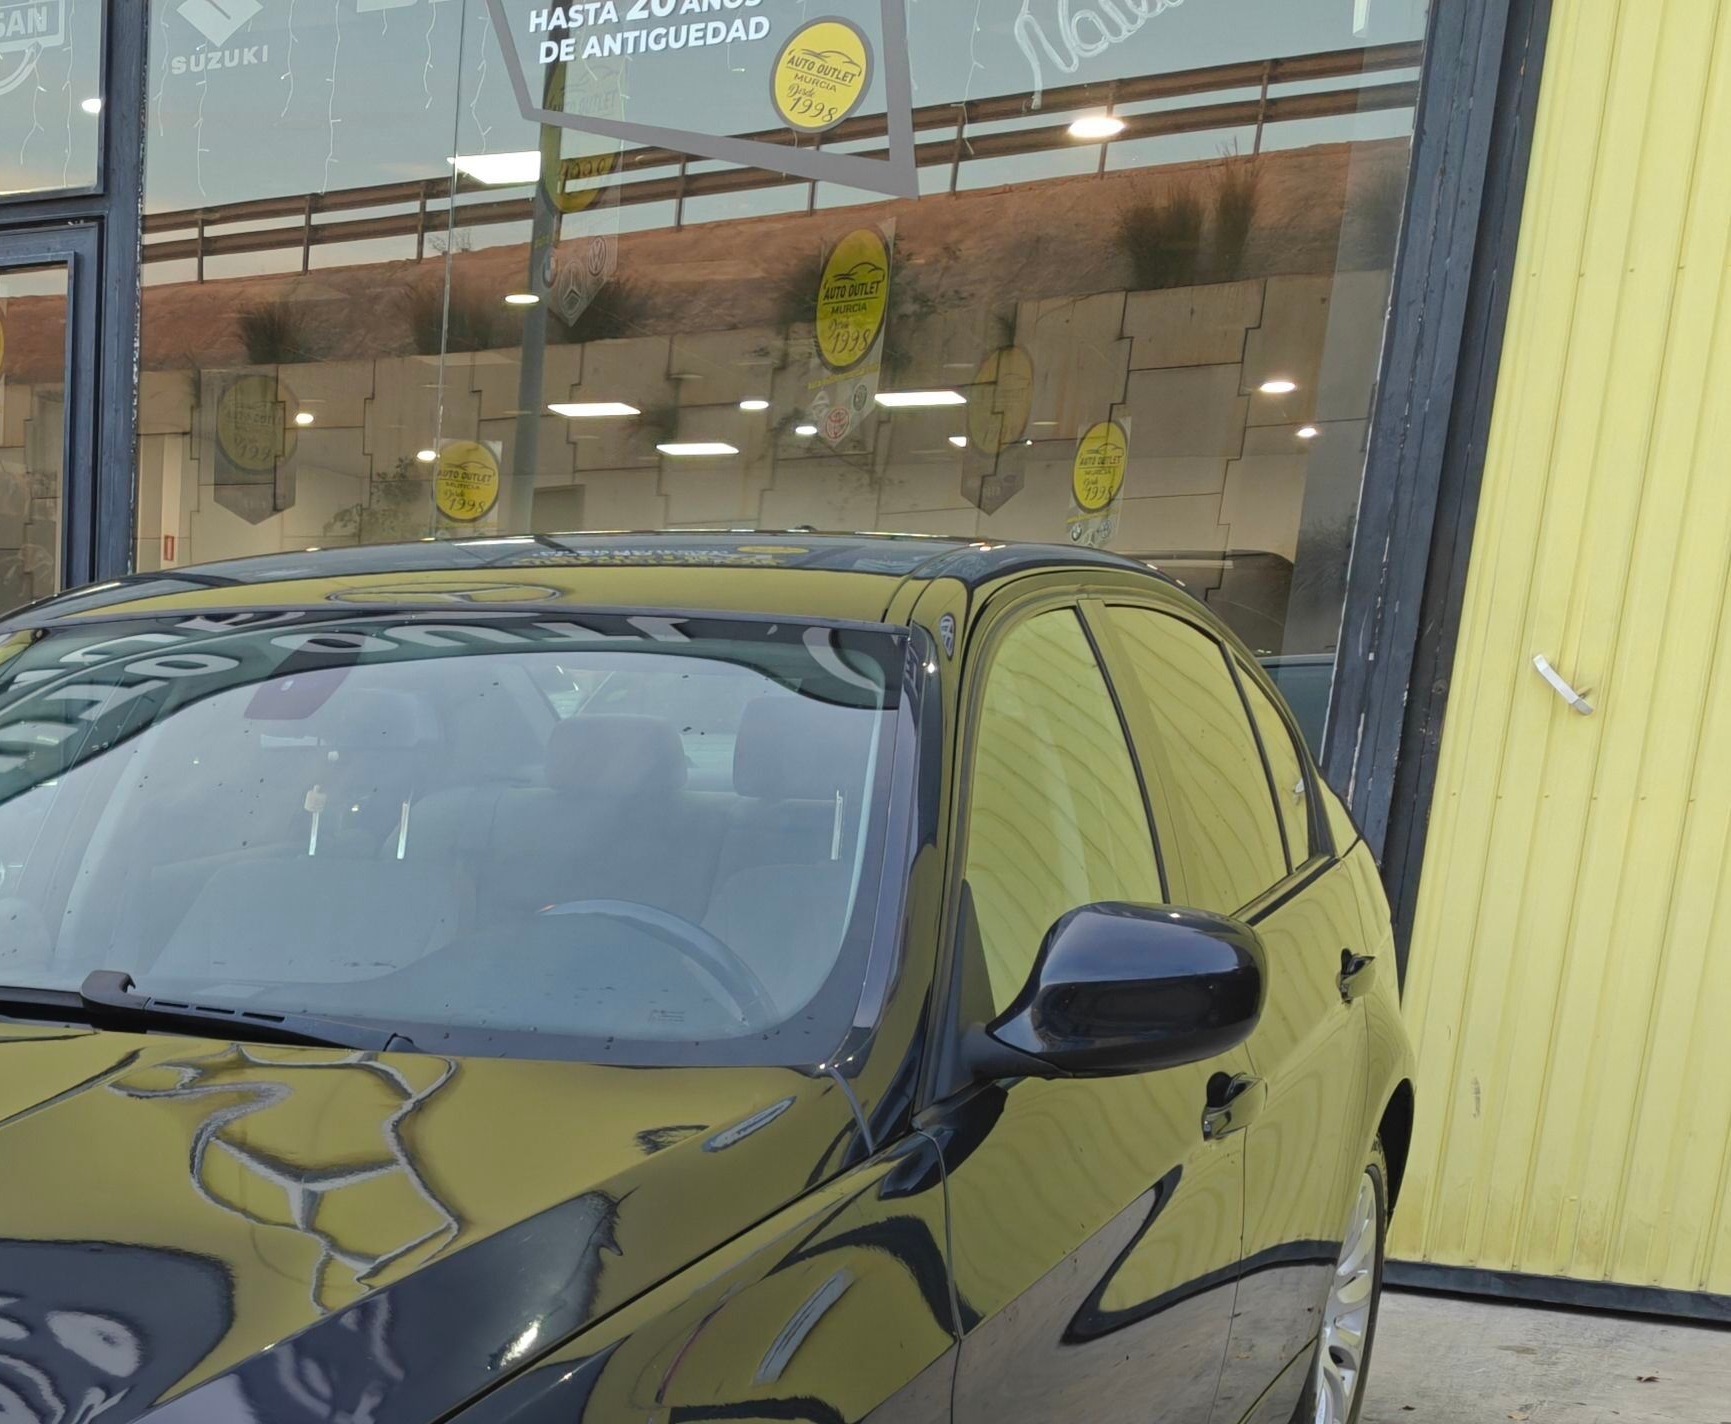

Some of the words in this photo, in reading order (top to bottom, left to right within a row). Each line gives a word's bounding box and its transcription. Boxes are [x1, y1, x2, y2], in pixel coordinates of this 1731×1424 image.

[529, 0, 619, 33] HASTA
[539, 38, 576, 64] DE
[581, 16, 771, 59] ANTIGUEDAD
[171, 45, 269, 75] SUZUKI
[786, 55, 815, 71] AUTO
[816, 64, 857, 84] OUTLET
[794, 73, 837, 93] MURCIA
[789, 96, 838, 123] 1998
[823, 285, 847, 301] AUTO
[848, 280, 881, 298] OUTLET
[830, 302, 868, 315] MURCIA
